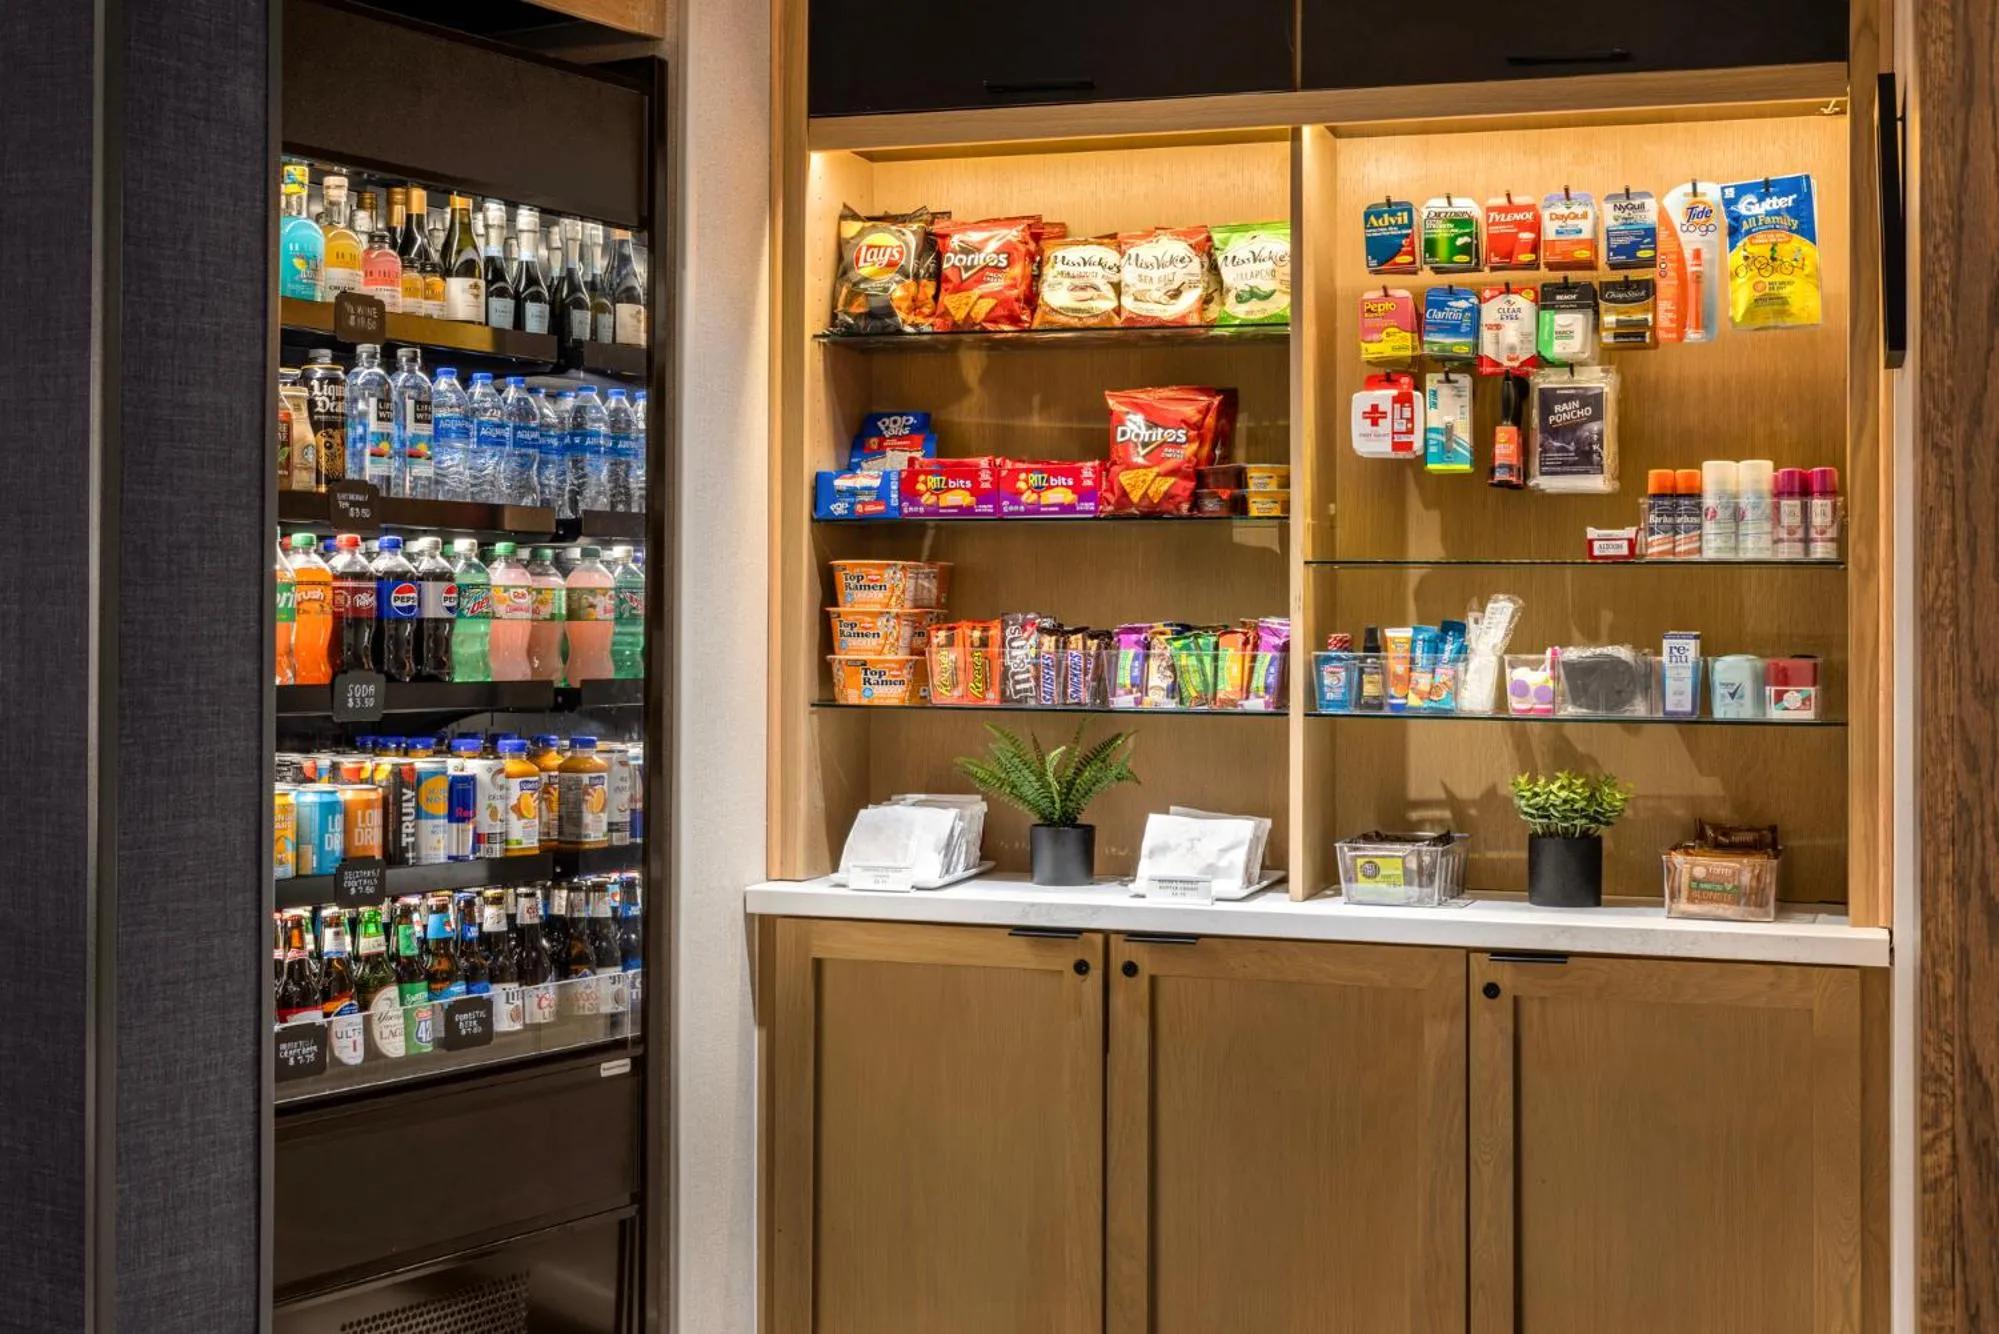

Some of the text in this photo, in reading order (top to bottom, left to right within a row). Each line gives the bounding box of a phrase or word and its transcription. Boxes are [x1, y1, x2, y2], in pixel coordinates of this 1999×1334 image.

[1613, 202, 1645, 214] NyQuil
[1738, 193, 1798, 216] Cutter
[1367, 211, 1408, 227] Advil
[1488, 211, 1534, 223] TYLENOL
[1549, 211, 1588, 222] DayQuil
[1686, 206, 1713, 222] Tide
[1742, 216, 1756, 230] All
[1758, 216, 1798, 230] Family
[1680, 224, 1717, 236] to go
[943, 252, 1008, 270] Doritos
[1123, 252, 1154, 270] Miss
[1220, 255, 1251, 268] Miss
[1364, 300, 1396, 312] Pepto
[1426, 308, 1462, 320] Claritin
[1554, 400, 1580, 414] RAIN
[1548, 407, 1592, 424] PONCHO
[1116, 425, 1188, 444] Doritos
[927, 476, 972, 488] RITZ bits
[1028, 473, 1074, 487] RITZ bits
[843, 572, 865, 584] Top
[844, 582, 887, 592] Ramen
[838, 620, 858, 630] Top
[838, 629, 880, 638] Ramen
[862, 668, 887, 680] Top
[1042, 652, 1054, 702] SATISFIES
[1070, 652, 1083, 701] SNICKERS
[862, 677, 906, 686] Ramen
[347, 684, 375, 698] SODA
[347, 698, 375, 708] $3.50
[402, 788, 416, 847] TRULY
